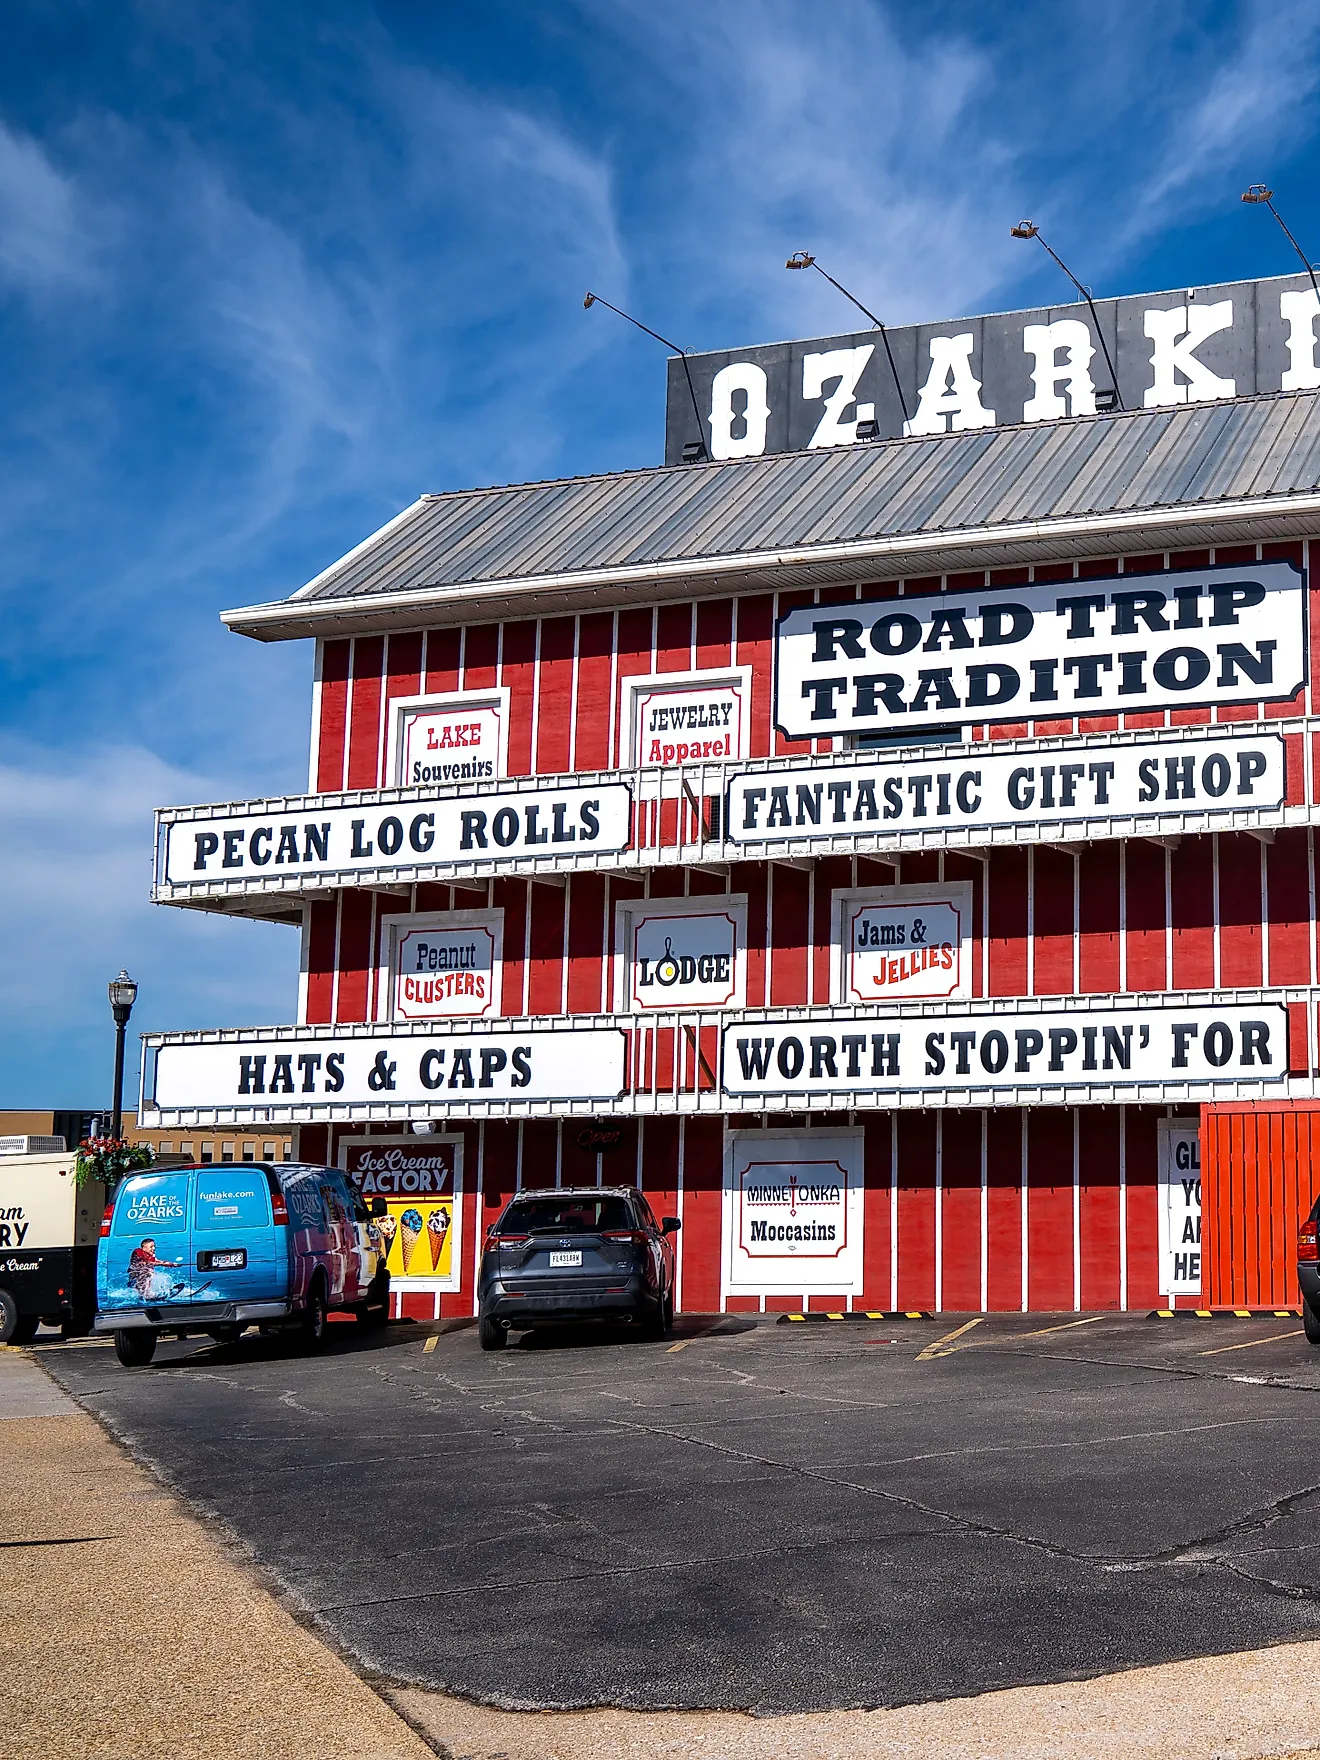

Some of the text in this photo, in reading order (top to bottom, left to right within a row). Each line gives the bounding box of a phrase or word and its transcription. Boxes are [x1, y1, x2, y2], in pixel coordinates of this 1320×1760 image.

[812, 581, 1266, 662] ROAD TRIP
[801, 640, 1277, 721] TRADITION
[650, 702, 732, 732] JEWELRY
[427, 723, 481, 750] LAKE
[649, 734, 731, 765] Apparel
[413, 756, 492, 783] Souvenirs
[743, 751, 1268, 829] FANTASTIC GIFT SHOP
[193, 799, 600, 870] PECAN LOG ROLLS
[858, 918, 927, 946] Jams &
[416, 943, 476, 970] Peanut
[639, 950, 730, 986] LODGE
[873, 942, 953, 985] JELLIES
[405, 972, 485, 1003] CLUSTERS
[736, 1020, 1273, 1080] WORTH STOPPIN' FOR
[237, 1046, 532, 1094] HATS & CAPS
[577, 1129, 620, 1146] Open
[352, 1169, 449, 1192] FACTORY
[747, 1184, 840, 1203] MINNETONKA
[132, 1195, 167, 1208] LAKE
[199, 1191, 254, 1200] funlake.com
[127, 1205, 183, 1219] OZARKS
[751, 1220, 835, 1241] Moccasins
[7, 1258, 43, 1271] Cream"
